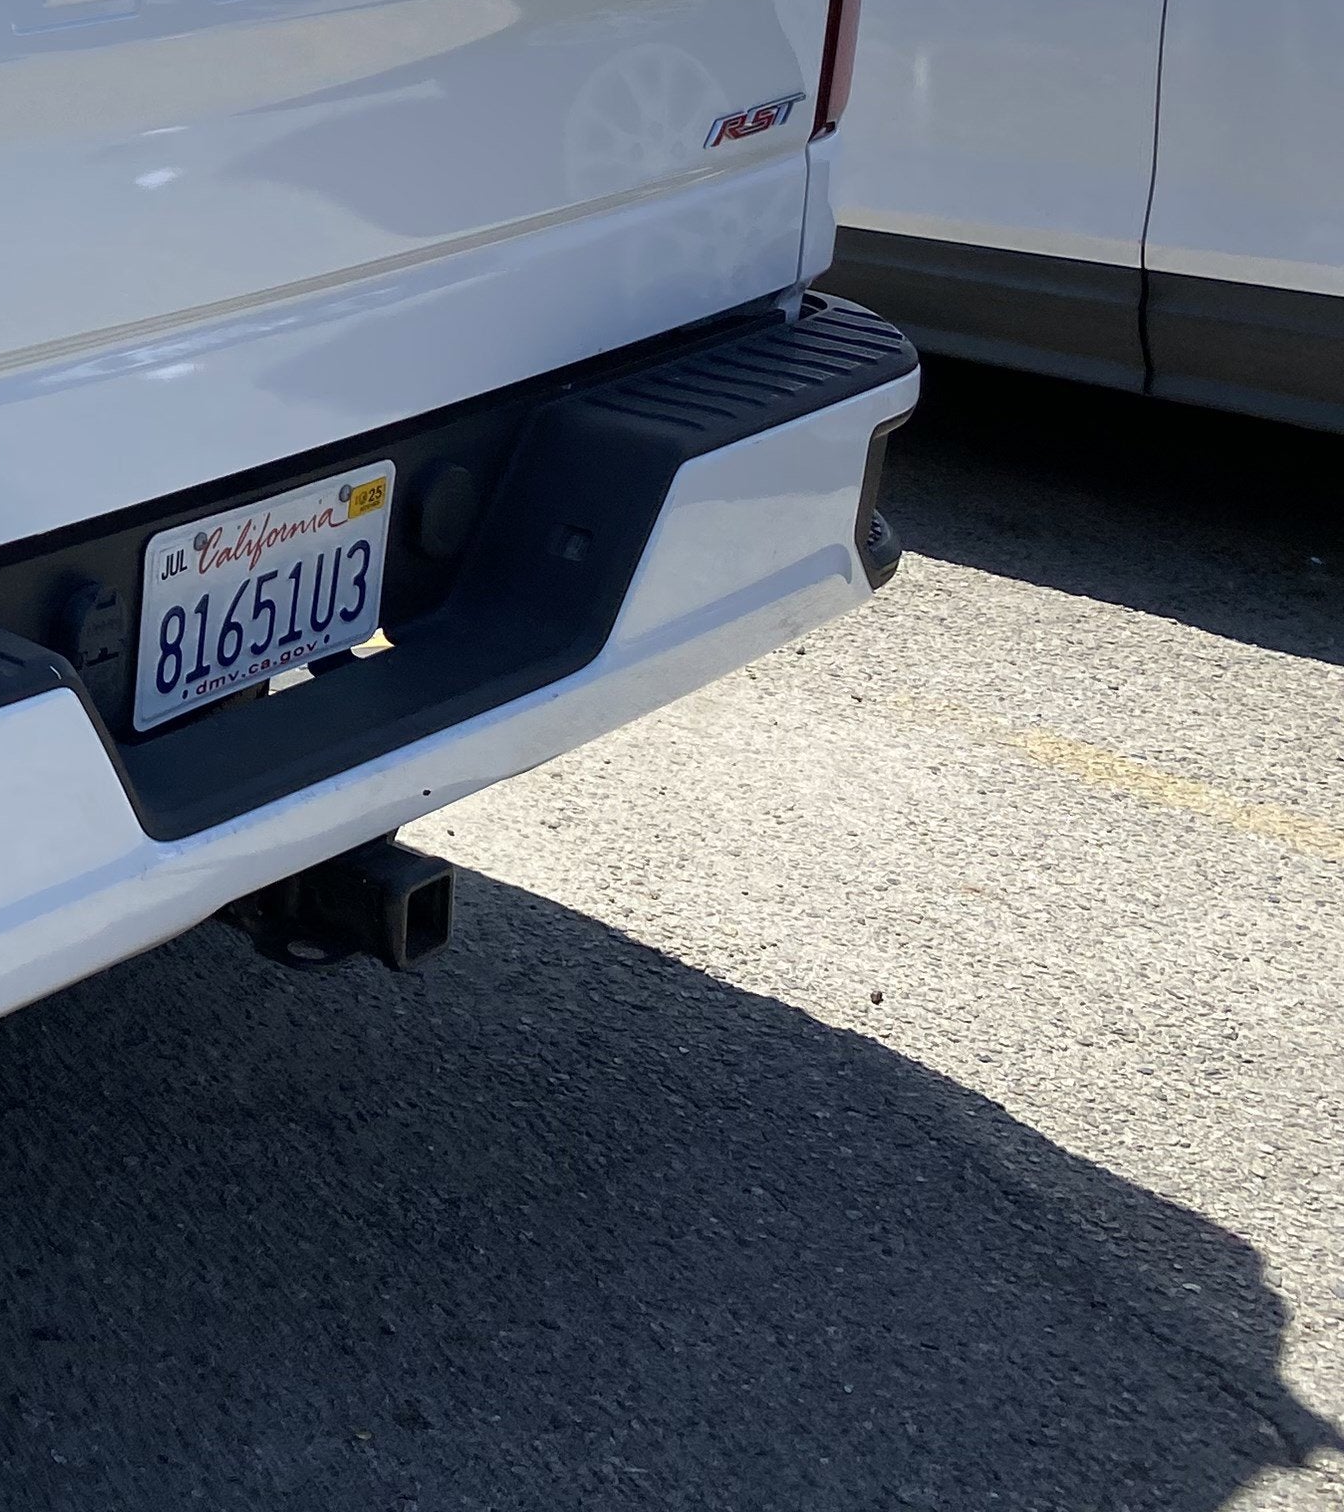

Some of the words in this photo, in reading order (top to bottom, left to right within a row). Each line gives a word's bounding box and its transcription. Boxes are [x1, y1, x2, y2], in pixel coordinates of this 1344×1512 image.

[703, 92, 806, 149] RST
[161, 548, 188, 580] JUL
[198, 506, 348, 575] California
[156, 539, 371, 694] 81651U3
[195, 641, 319, 696] dmv.ca.gov
